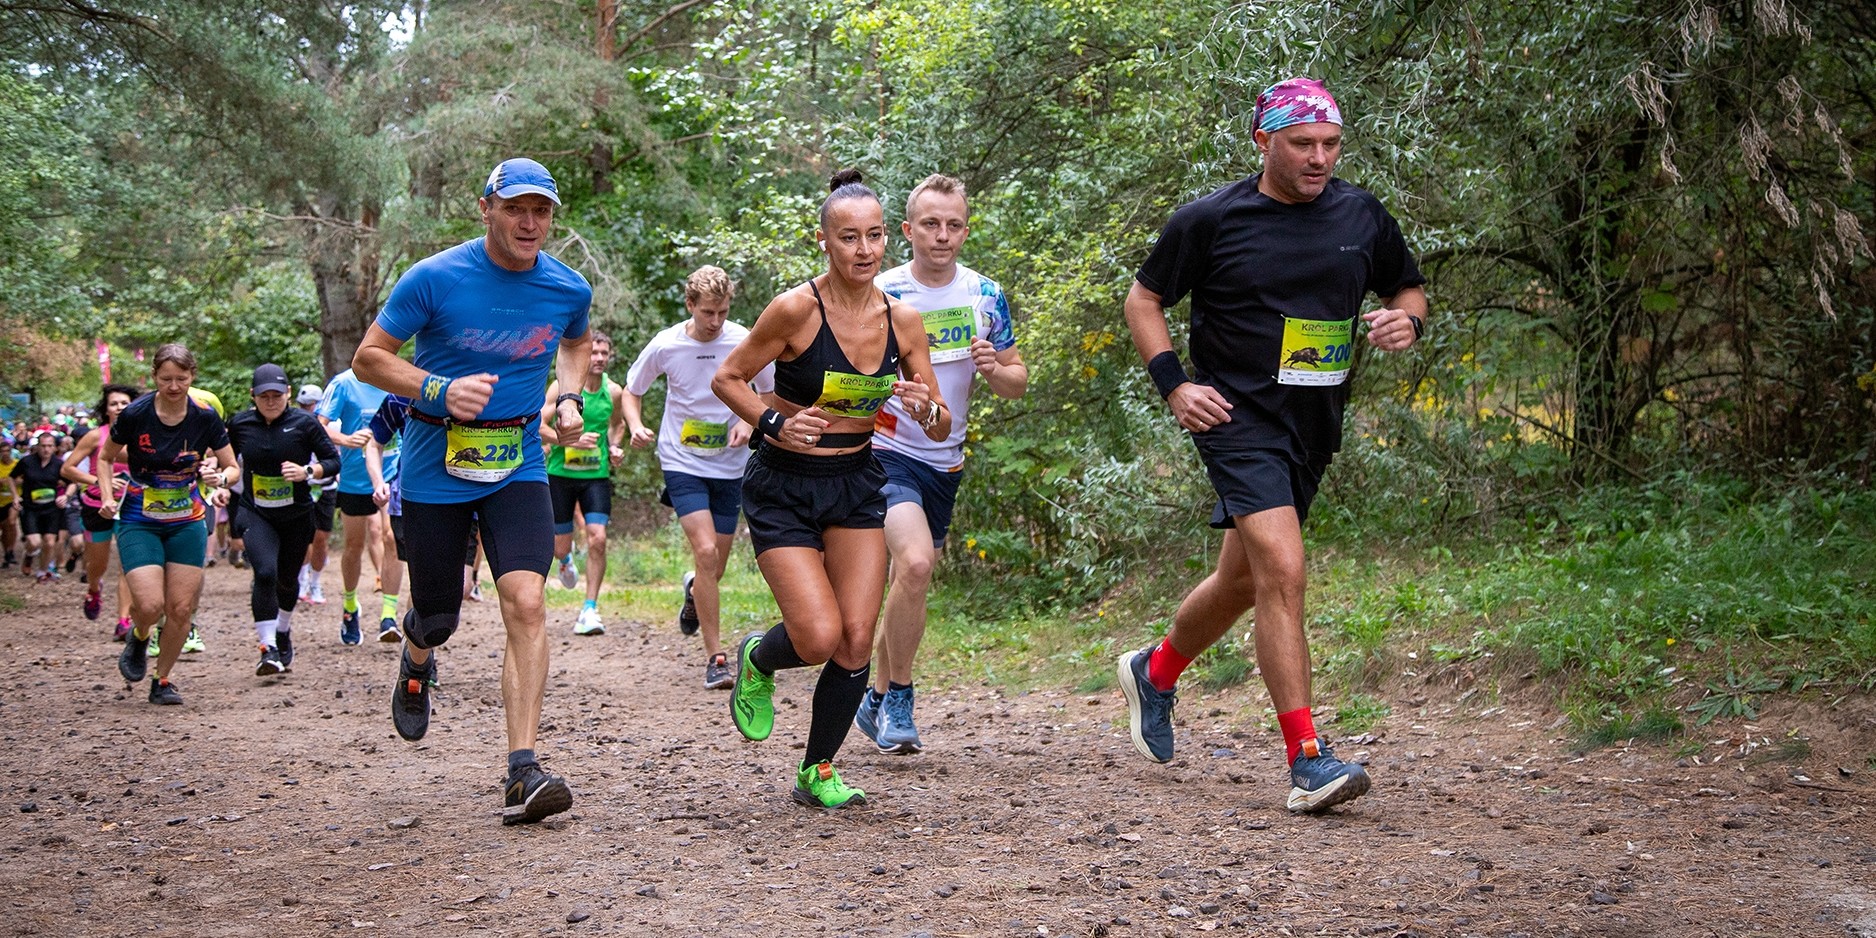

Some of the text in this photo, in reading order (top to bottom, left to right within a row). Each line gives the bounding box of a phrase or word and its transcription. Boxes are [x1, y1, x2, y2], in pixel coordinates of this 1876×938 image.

[940, 325, 971, 344] 201
[1302, 322, 1326, 332] KRÓL
[1320, 343, 1351, 363] 200
[840, 377, 862, 386] KRÓL
[483, 443, 519, 462] 226
[269, 486, 291, 497] 260
